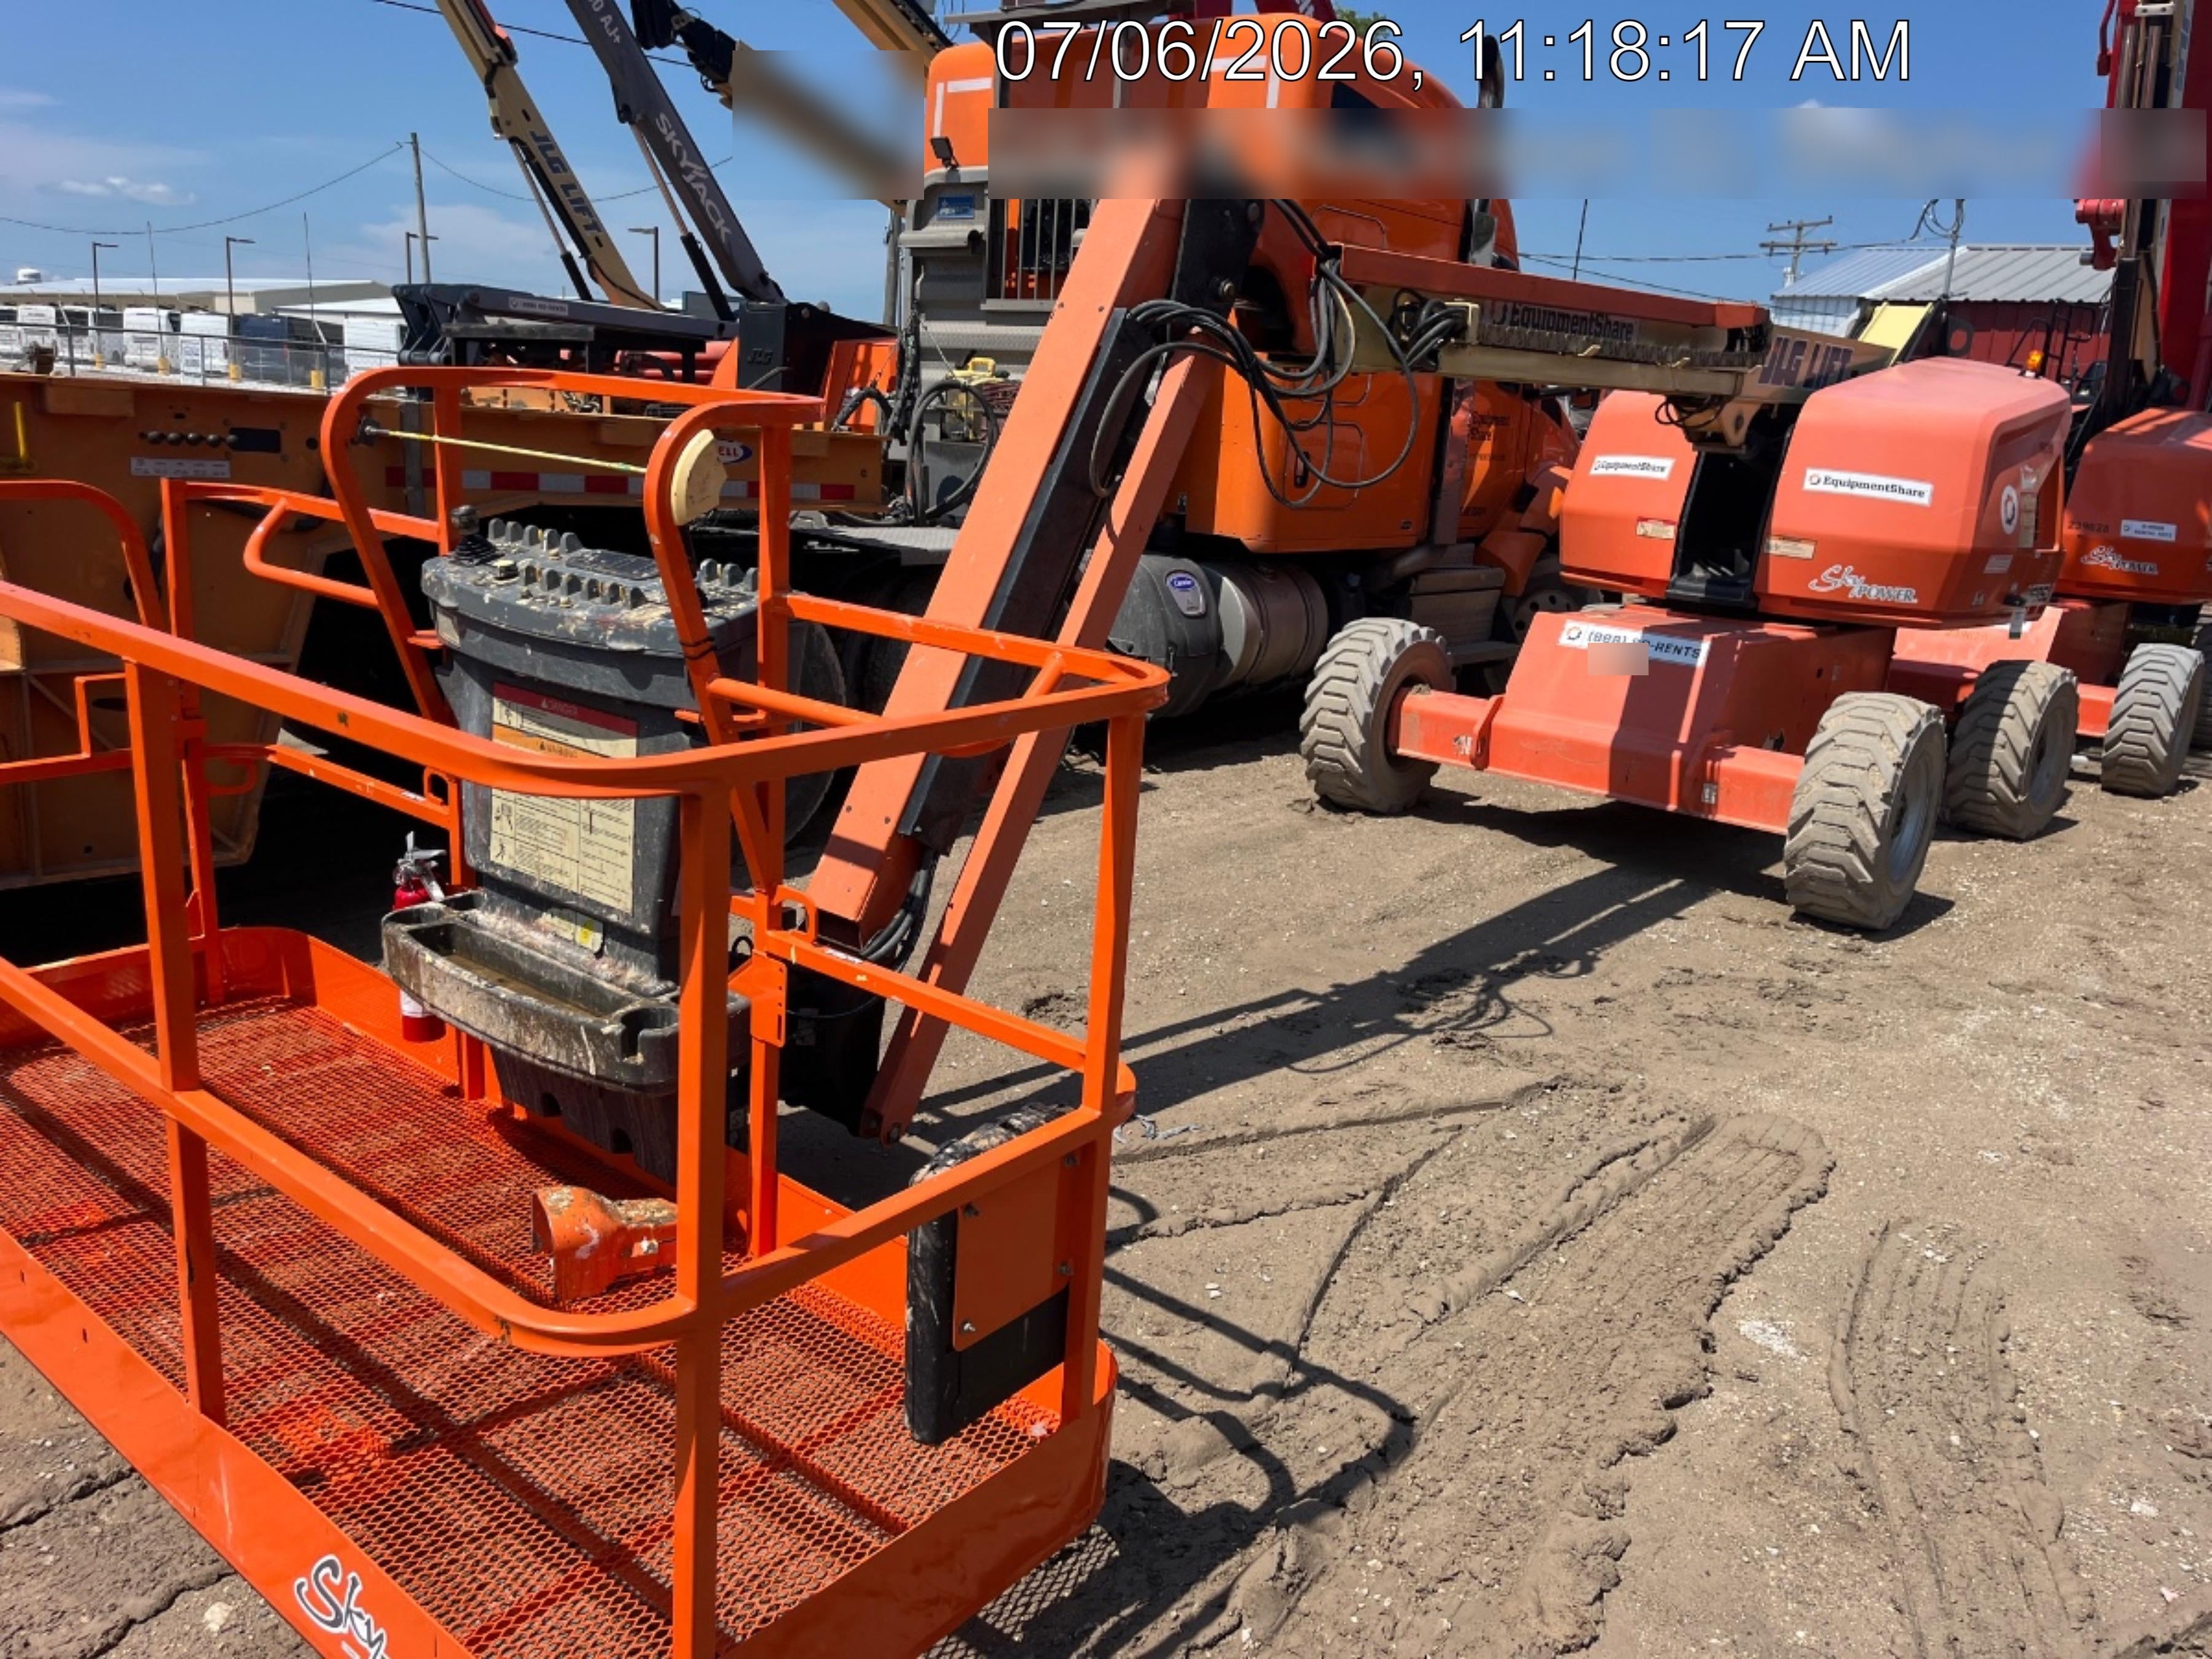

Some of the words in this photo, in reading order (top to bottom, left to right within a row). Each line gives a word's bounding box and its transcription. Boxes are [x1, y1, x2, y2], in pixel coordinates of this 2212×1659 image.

[529, 130, 568, 174] JLG
[560, 182, 602, 233] LIFT
[656, 112, 732, 243] SKYJACK
[1509, 303, 1634, 342] EquipmentShare
[747, 347, 774, 366] JLG
[1758, 336, 1808, 386] JLG
[1802, 342, 1854, 389] LIFT
[1822, 474, 1926, 498] EquipmentShare
[1808, 563, 1866, 599] Sky
[1857, 583, 1916, 603] POWER
[1632, 637, 1701, 659] -RENTS
